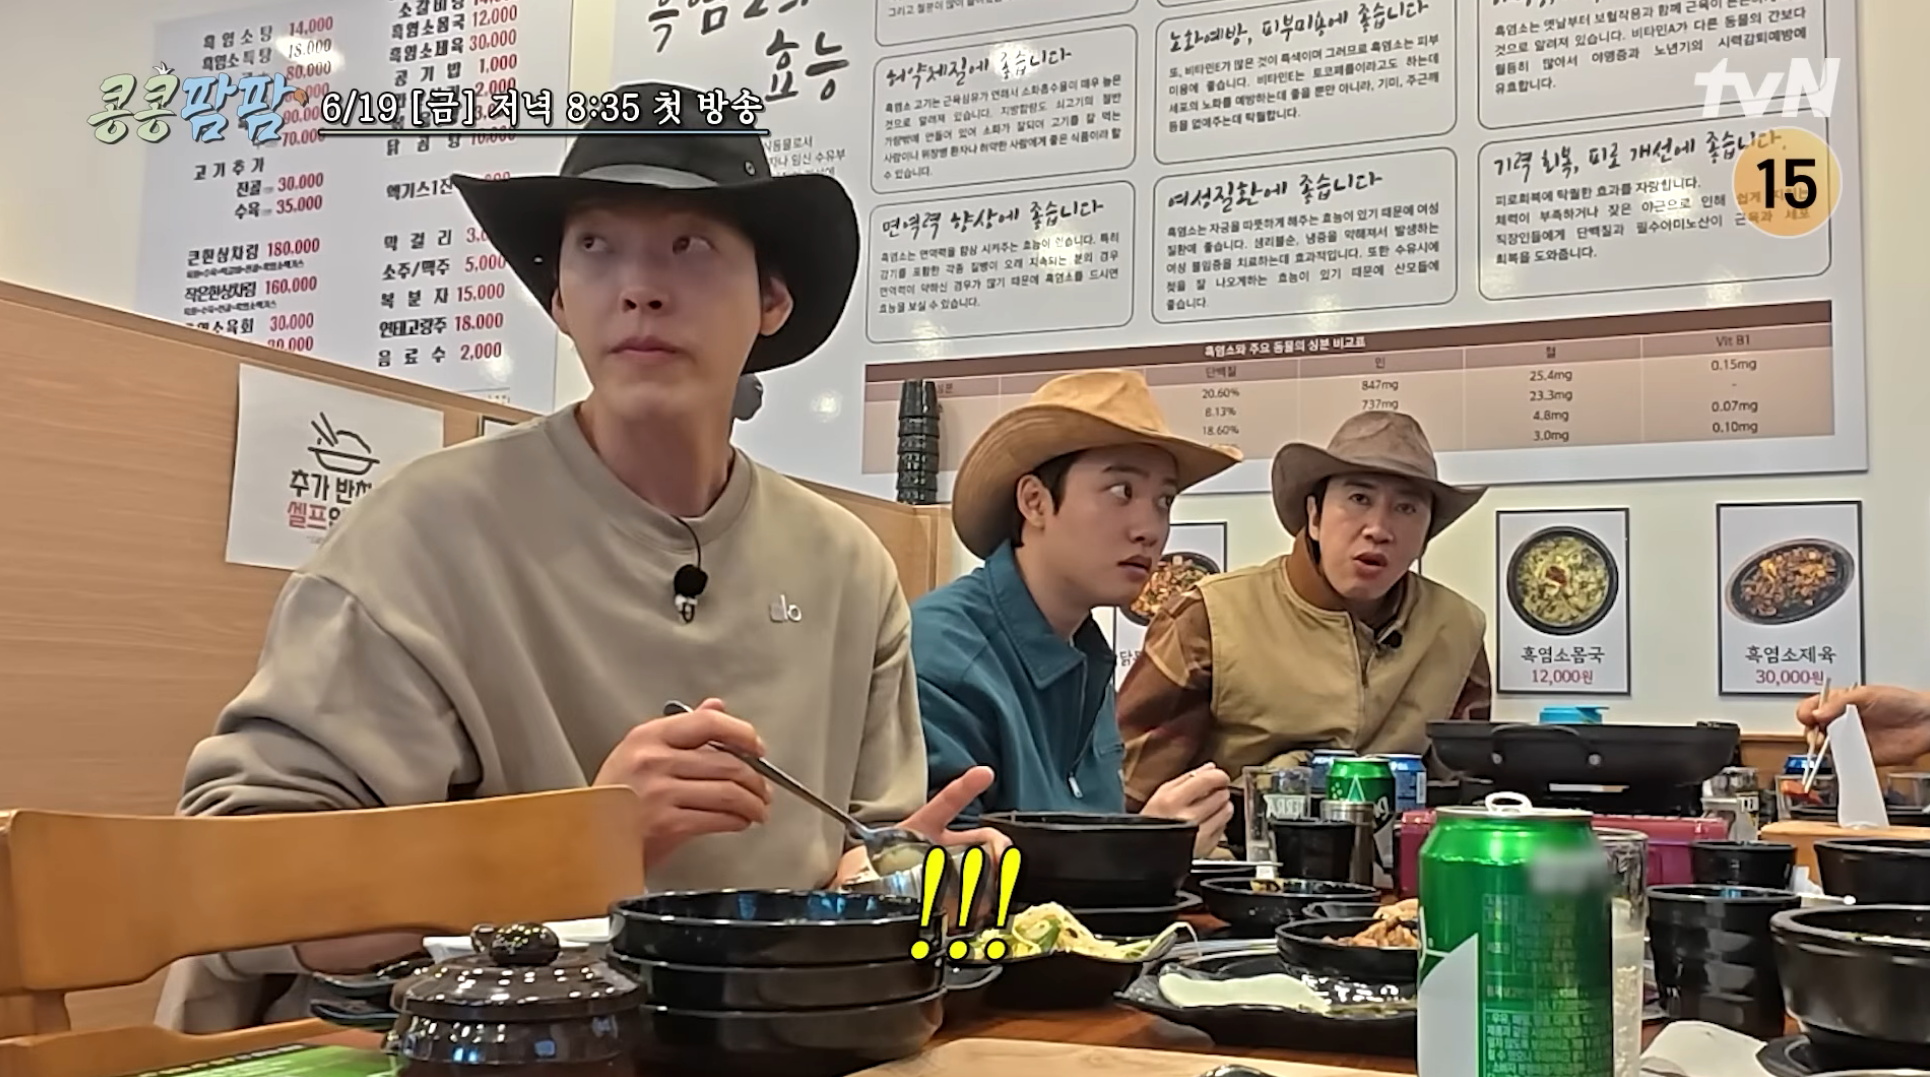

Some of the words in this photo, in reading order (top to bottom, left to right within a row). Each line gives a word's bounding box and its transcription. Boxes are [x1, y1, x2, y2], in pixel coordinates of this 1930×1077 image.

[473, 4, 517, 28] 12,000
[1170, 22, 1253, 53] 노화예방,
[1262, 10, 1349, 42] 피부미용에
[1358, 0, 1429, 33] 좋습니다
[764, 28, 850, 102] 효능
[1494, 151, 1533, 181] 기력
[1541, 145, 1579, 178] 회복,
[1589, 142, 1621, 170] 피로
[1630, 136, 1696, 163] 개선에
[1168, 181, 1288, 213] 여성질환에
[1299, 171, 1383, 205] 좋습니다
[234, 201, 260, 220] 수육
[882, 212, 942, 241] 면역력
[950, 207, 1020, 233] 향상에
[1030, 199, 1104, 230] 좋습니다
[1716, 334, 1733, 348] Vit
[1736, 334, 1751, 347] B1
[1201, 387, 1240, 399] 20.60%
[1361, 379, 1399, 393] 847mg
[1529, 369, 1573, 385] 25.4mg
[1710, 358, 1757, 374] 0.15mg
[1201, 424, 1240, 437] 18.60%
[1532, 408, 1570, 424] 4.8mg
[1710, 399, 1758, 415] 0.07mg
[1204, 405, 1238, 418] 8.13%
[1529, 388, 1573, 404] 23.3mg
[1532, 428, 1570, 444] 3.0mg
[1712, 419, 1759, 435] 0.10mg
[289, 469, 330, 501] 추가
[1745, 642, 1837, 664] 흑염소제육
[1531, 668, 1594, 687] 12,000원
[1755, 667, 1825, 688] 30,000원
